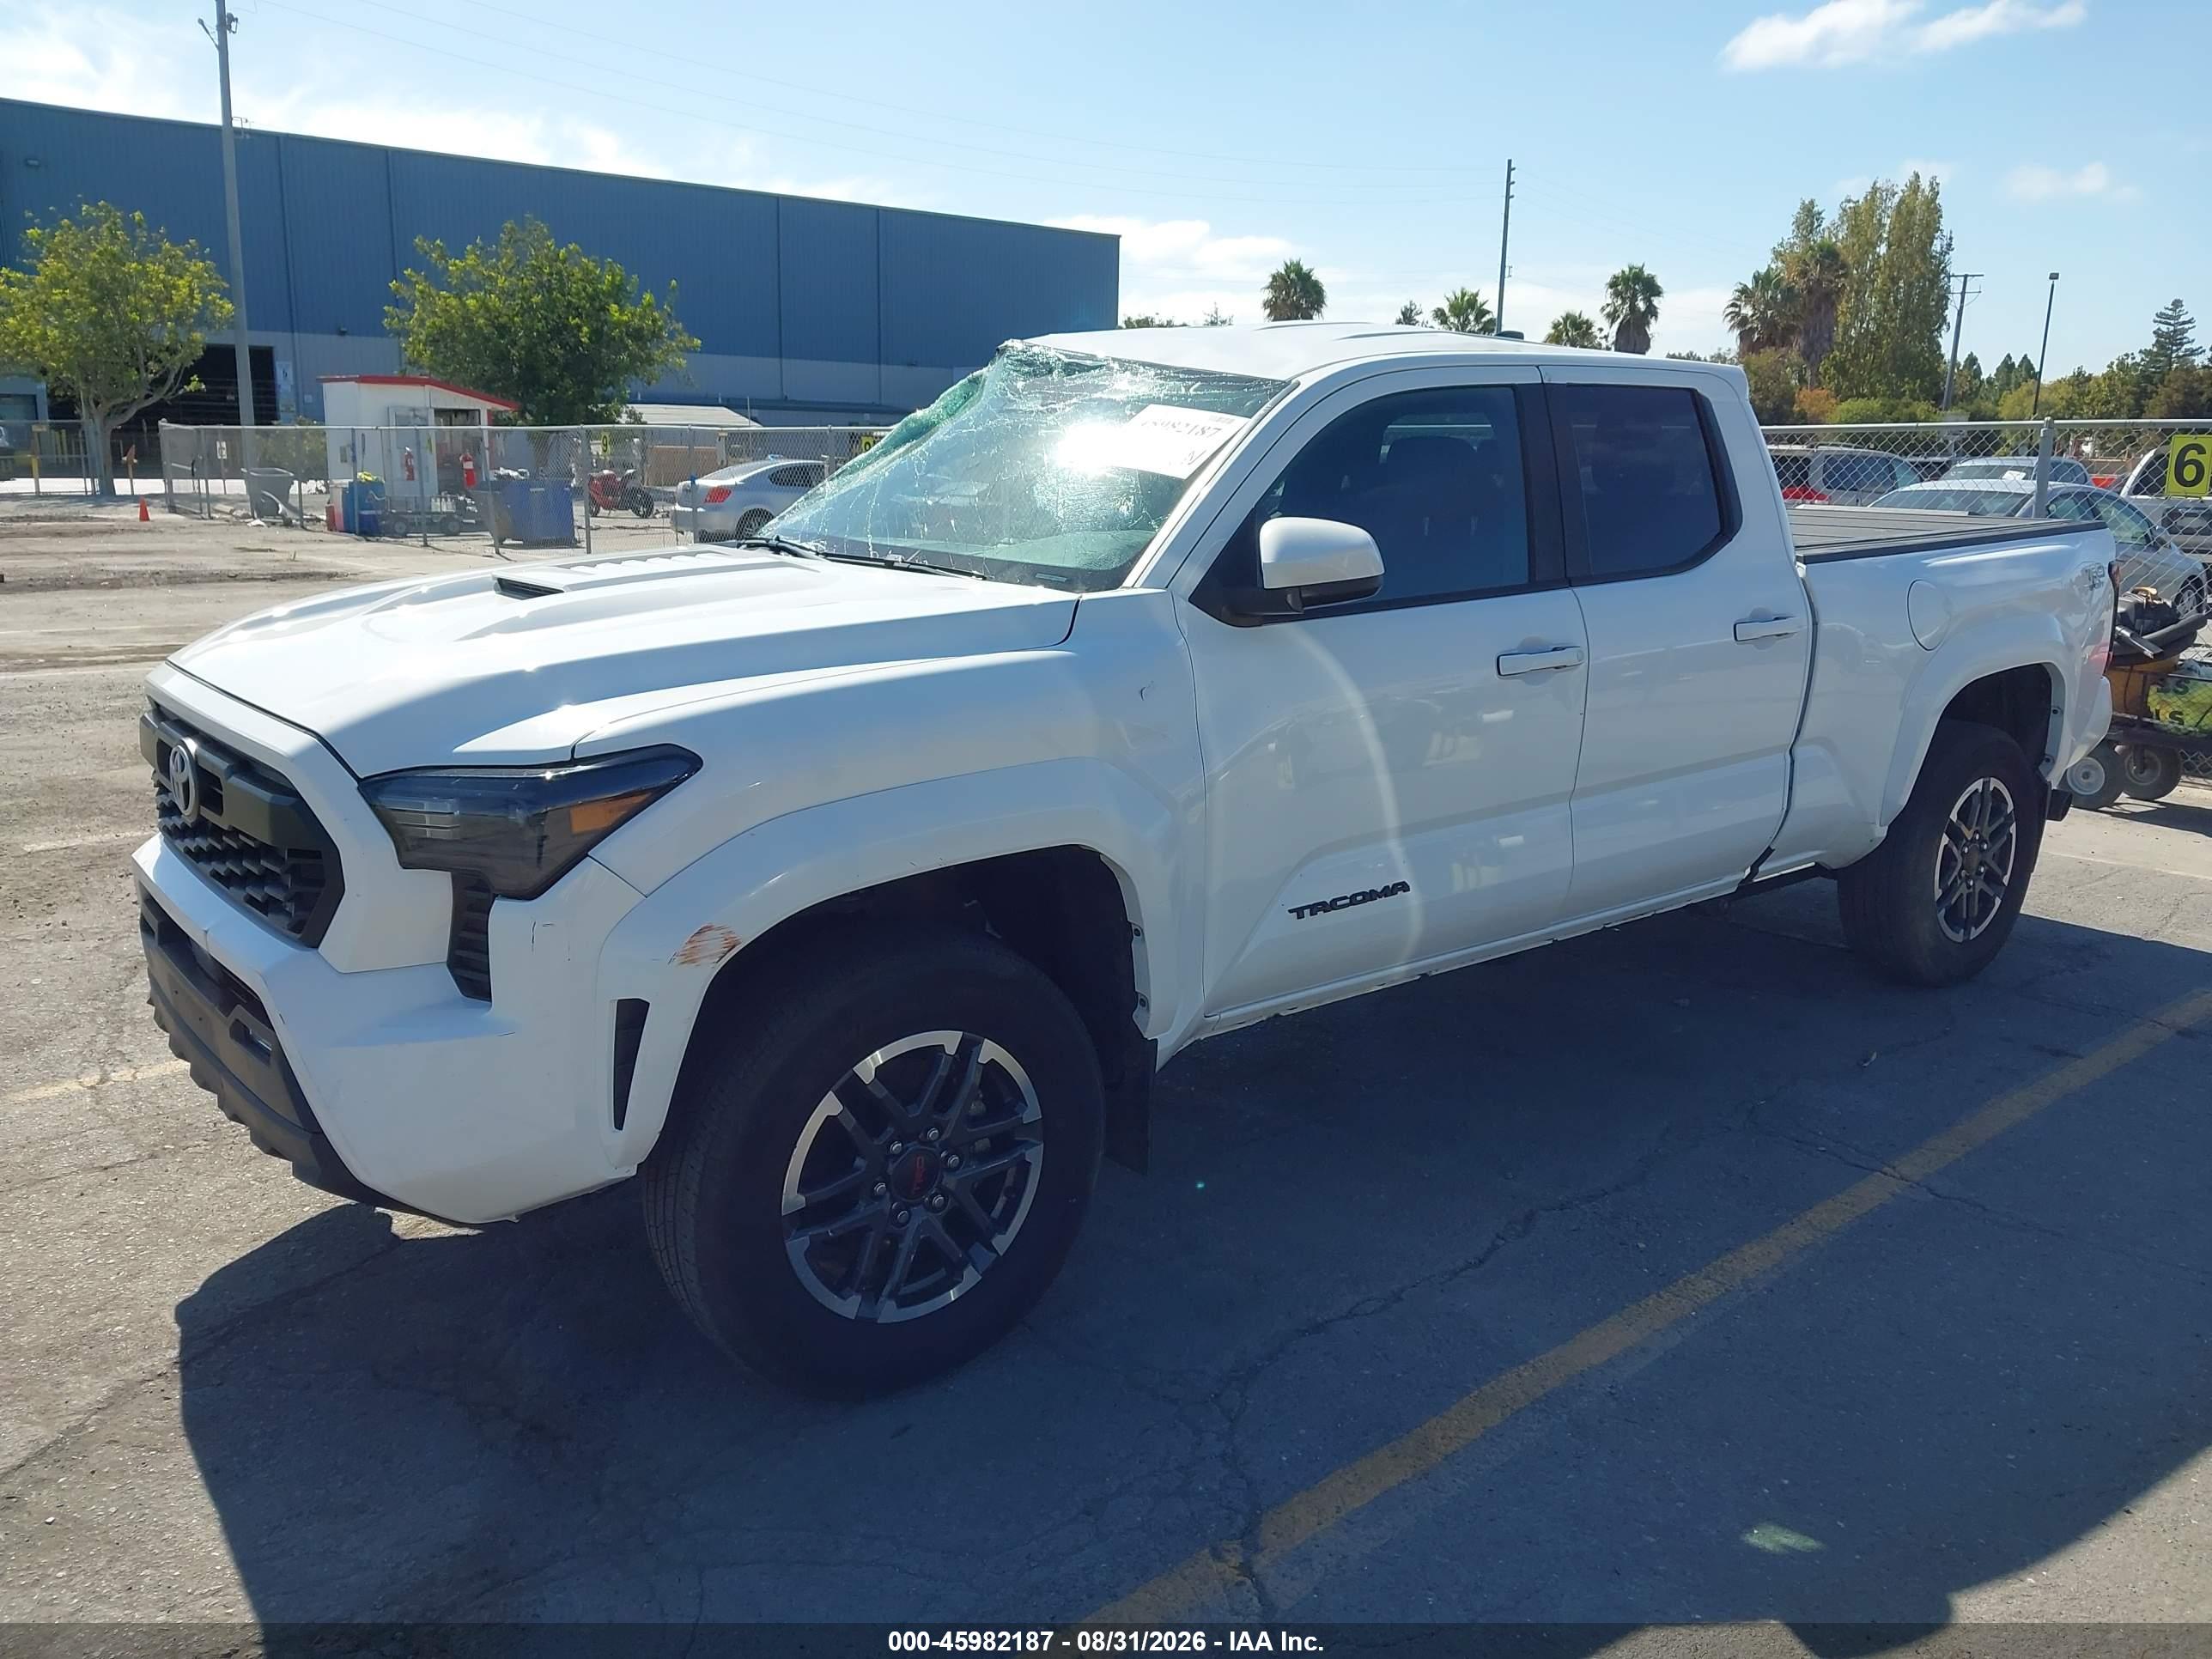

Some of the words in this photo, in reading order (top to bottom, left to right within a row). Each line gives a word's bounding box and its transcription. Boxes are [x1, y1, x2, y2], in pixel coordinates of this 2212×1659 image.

[602, 435, 608, 453] 9
[2174, 443, 2207, 488] 6
[1288, 881, 1411, 920] TACOMA
